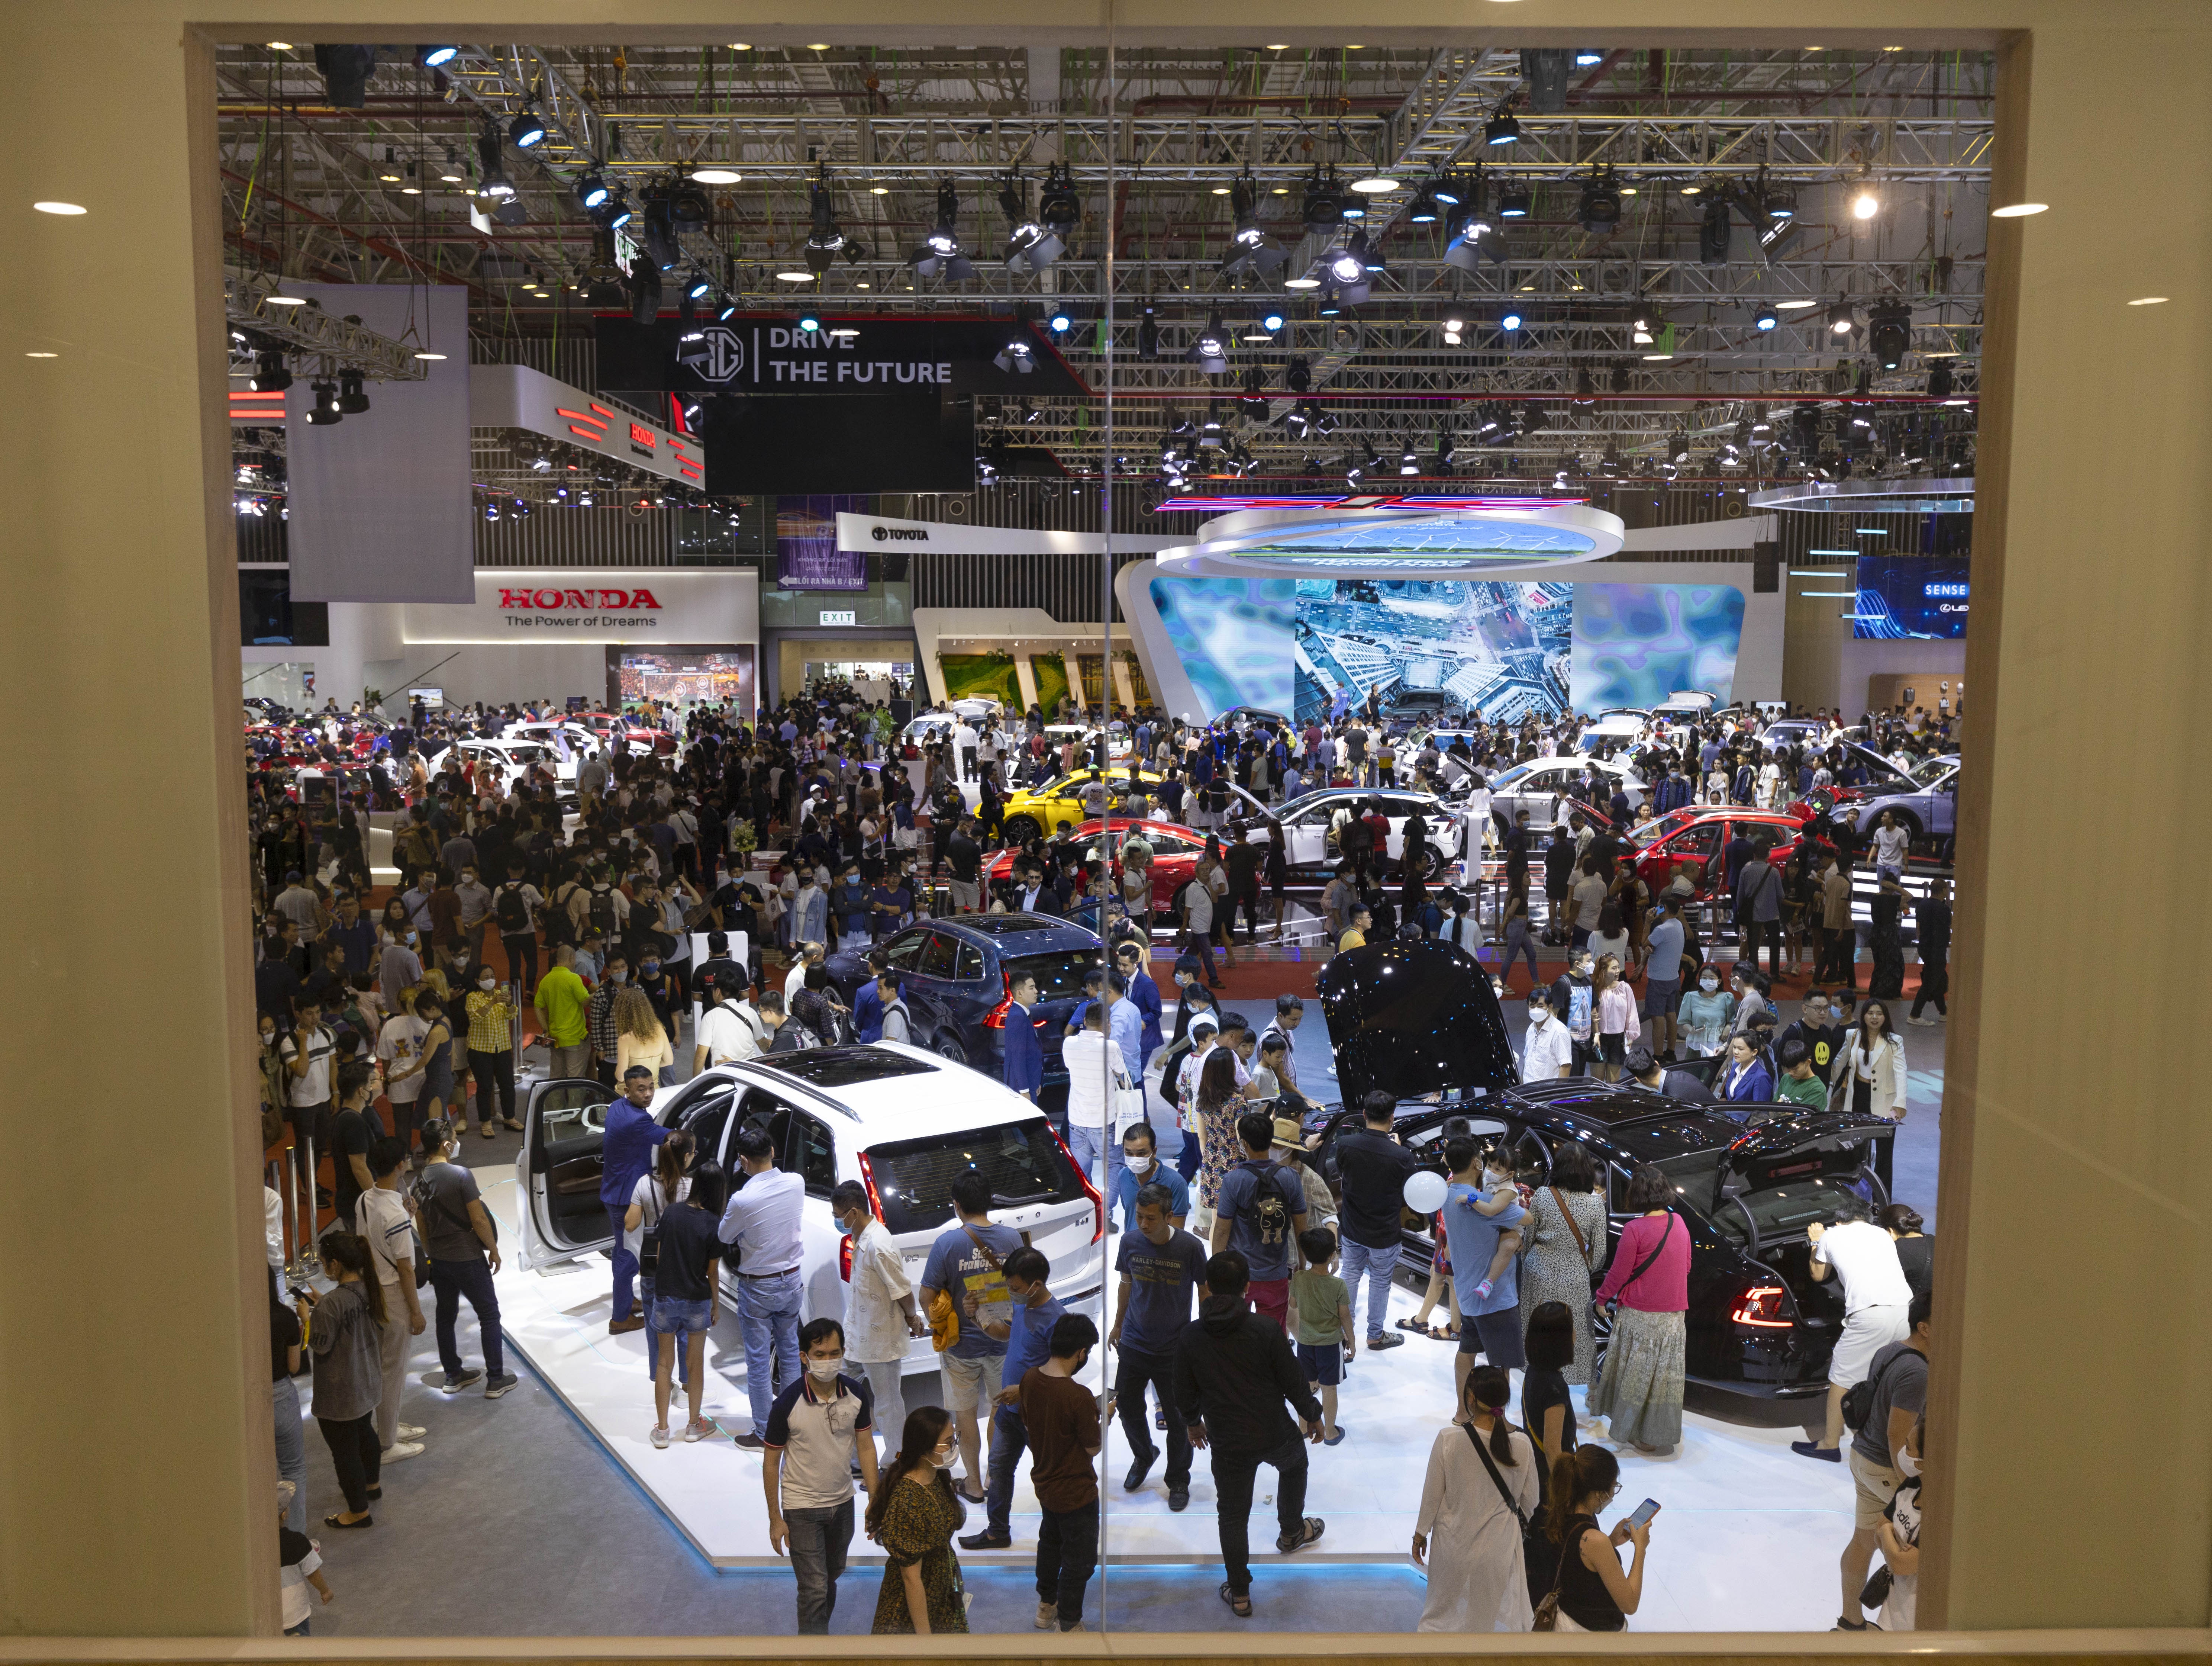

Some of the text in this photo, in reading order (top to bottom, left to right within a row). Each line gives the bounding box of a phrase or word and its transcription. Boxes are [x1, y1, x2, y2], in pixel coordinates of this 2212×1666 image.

[770, 328, 855, 349] DRIVE
[770, 361, 952, 383] THE FUTURE
[631, 423, 656, 448] HONDA
[888, 530, 929, 540] TOYOTA
[1926, 585, 1966, 595] SENSE
[499, 589, 662, 609] HONDA
[506, 616, 657, 626] The Power of Dreams
[1571, 985, 1585, 996] STEVE
[1132, 1256, 1181, 1269] HARLEY-DAVIDSON
